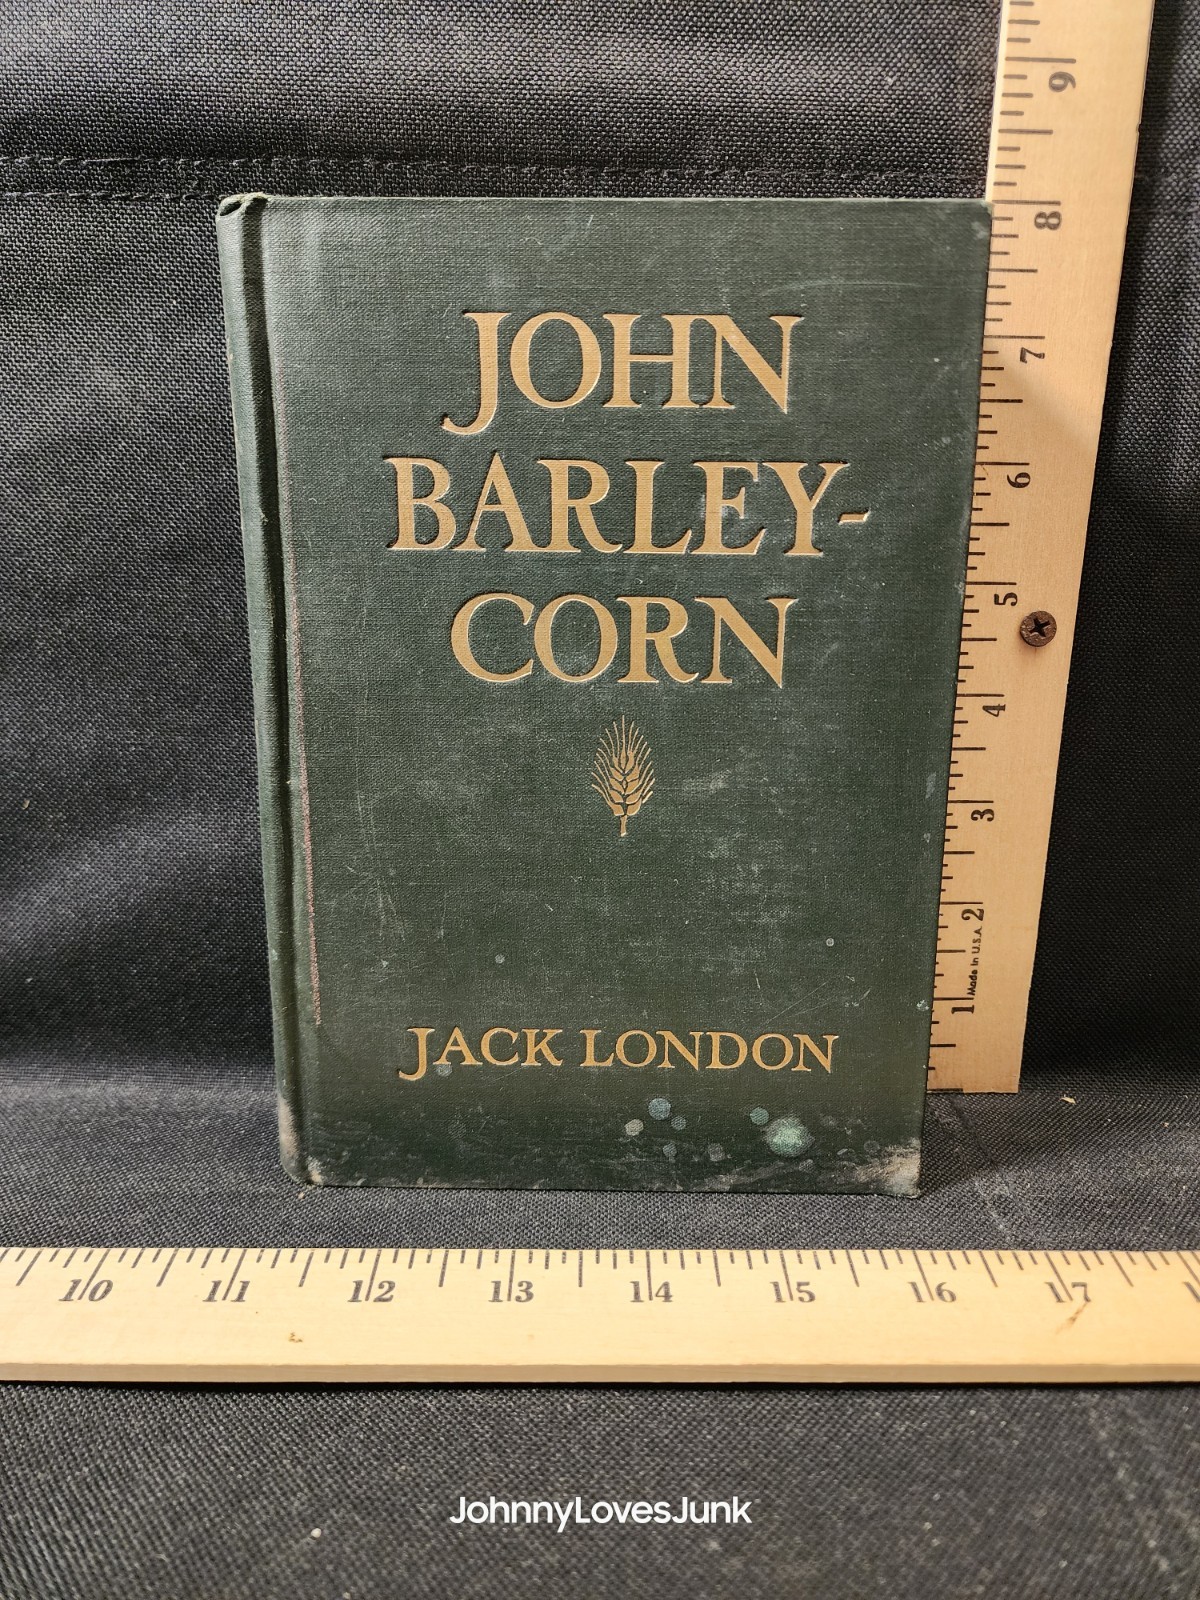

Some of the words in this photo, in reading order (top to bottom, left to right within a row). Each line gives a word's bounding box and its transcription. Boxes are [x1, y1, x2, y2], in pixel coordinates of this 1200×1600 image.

[1048, 71, 1076, 92] 9
[1034, 211, 1062, 231] 8
[1019, 347, 1045, 364] 7
[441, 311, 804, 435] JOHN
[1007, 472, 1031, 489] 6
[384, 452, 870, 556] BARLEY-
[994, 592, 1018, 607] 5
[450, 592, 799, 688] CORN
[982, 703, 1006, 718] 4
[970, 808, 995, 822] 3
[961, 908, 984, 921] 2
[966, 969, 978, 996] Made
[951, 1004, 975, 1015] 1
[398, 1026, 564, 1081] JACK
[580, 1029, 839, 1074] LONDON
[58, 1279, 114, 1302] 10
[202, 1280, 250, 1302] 11
[348, 1280, 396, 1303] 12
[488, 1281, 535, 1303] 13
[629, 1281, 674, 1303] 14
[769, 1281, 816, 1303] 15
[907, 1281, 957, 1303] 16
[1044, 1281, 1092, 1303] 17
